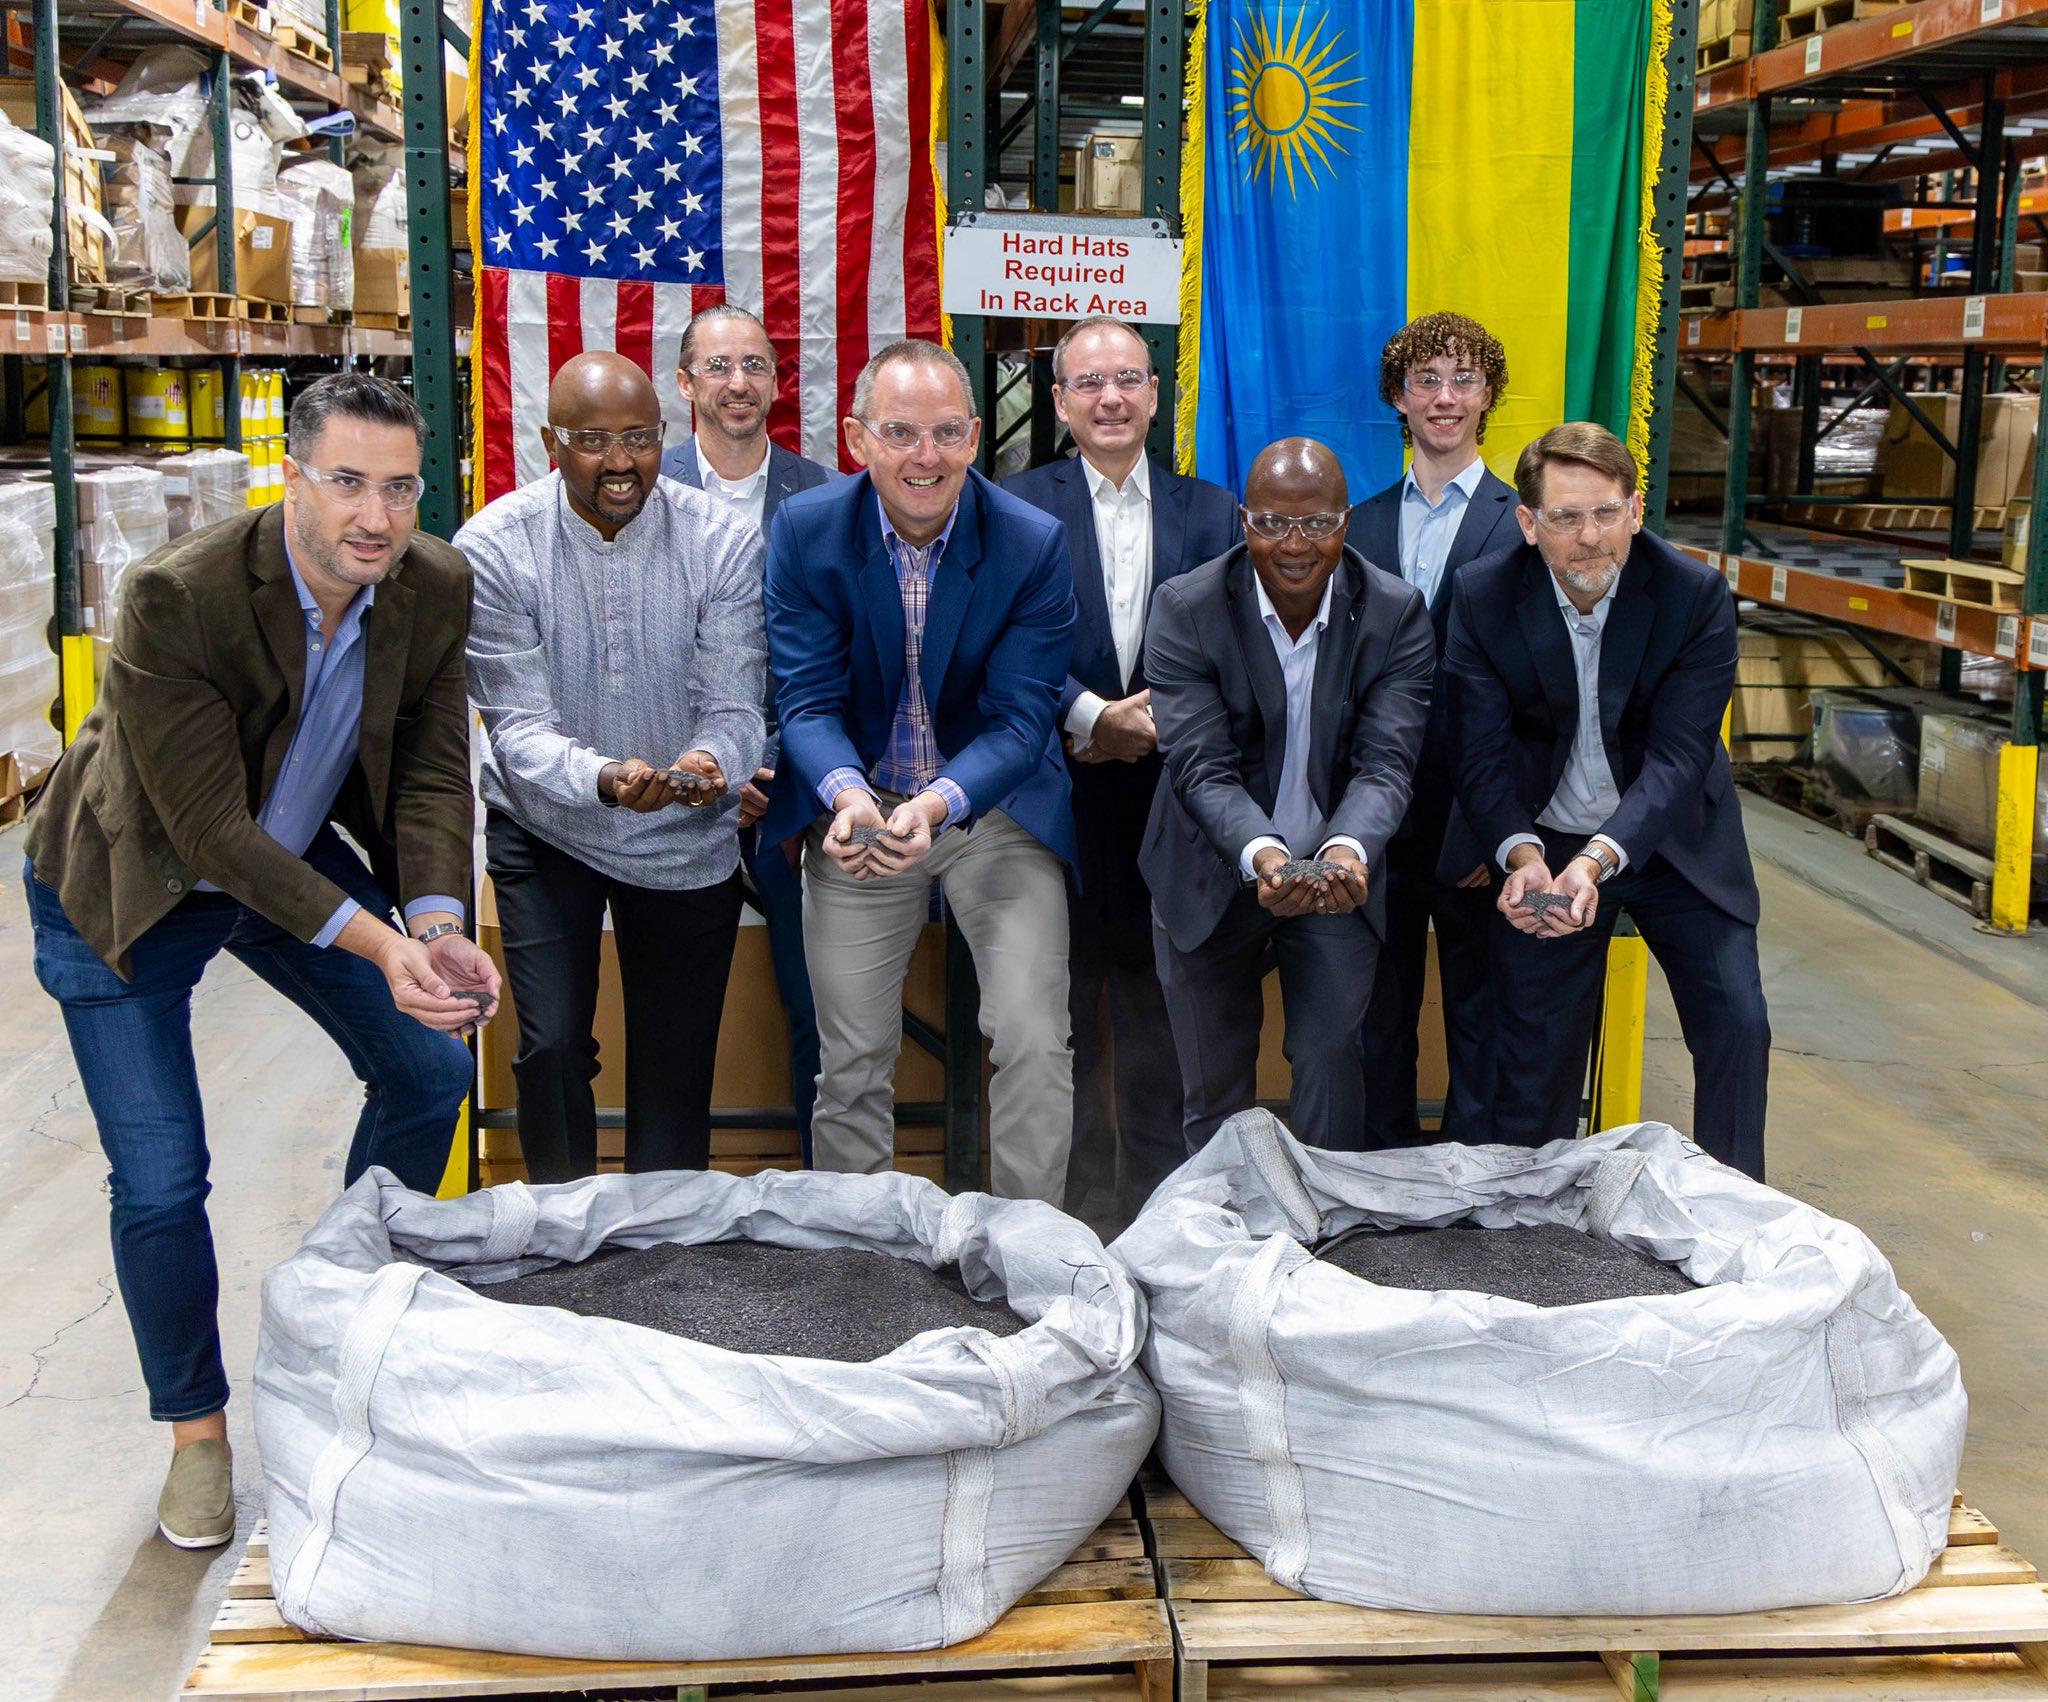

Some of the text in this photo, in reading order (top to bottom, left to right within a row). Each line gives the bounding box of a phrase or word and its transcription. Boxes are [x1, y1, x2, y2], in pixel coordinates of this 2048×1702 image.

[1003, 232, 1129, 257] Hard Hats
[1004, 259, 1124, 286] Required
[980, 289, 1147, 316] In Rack Area
